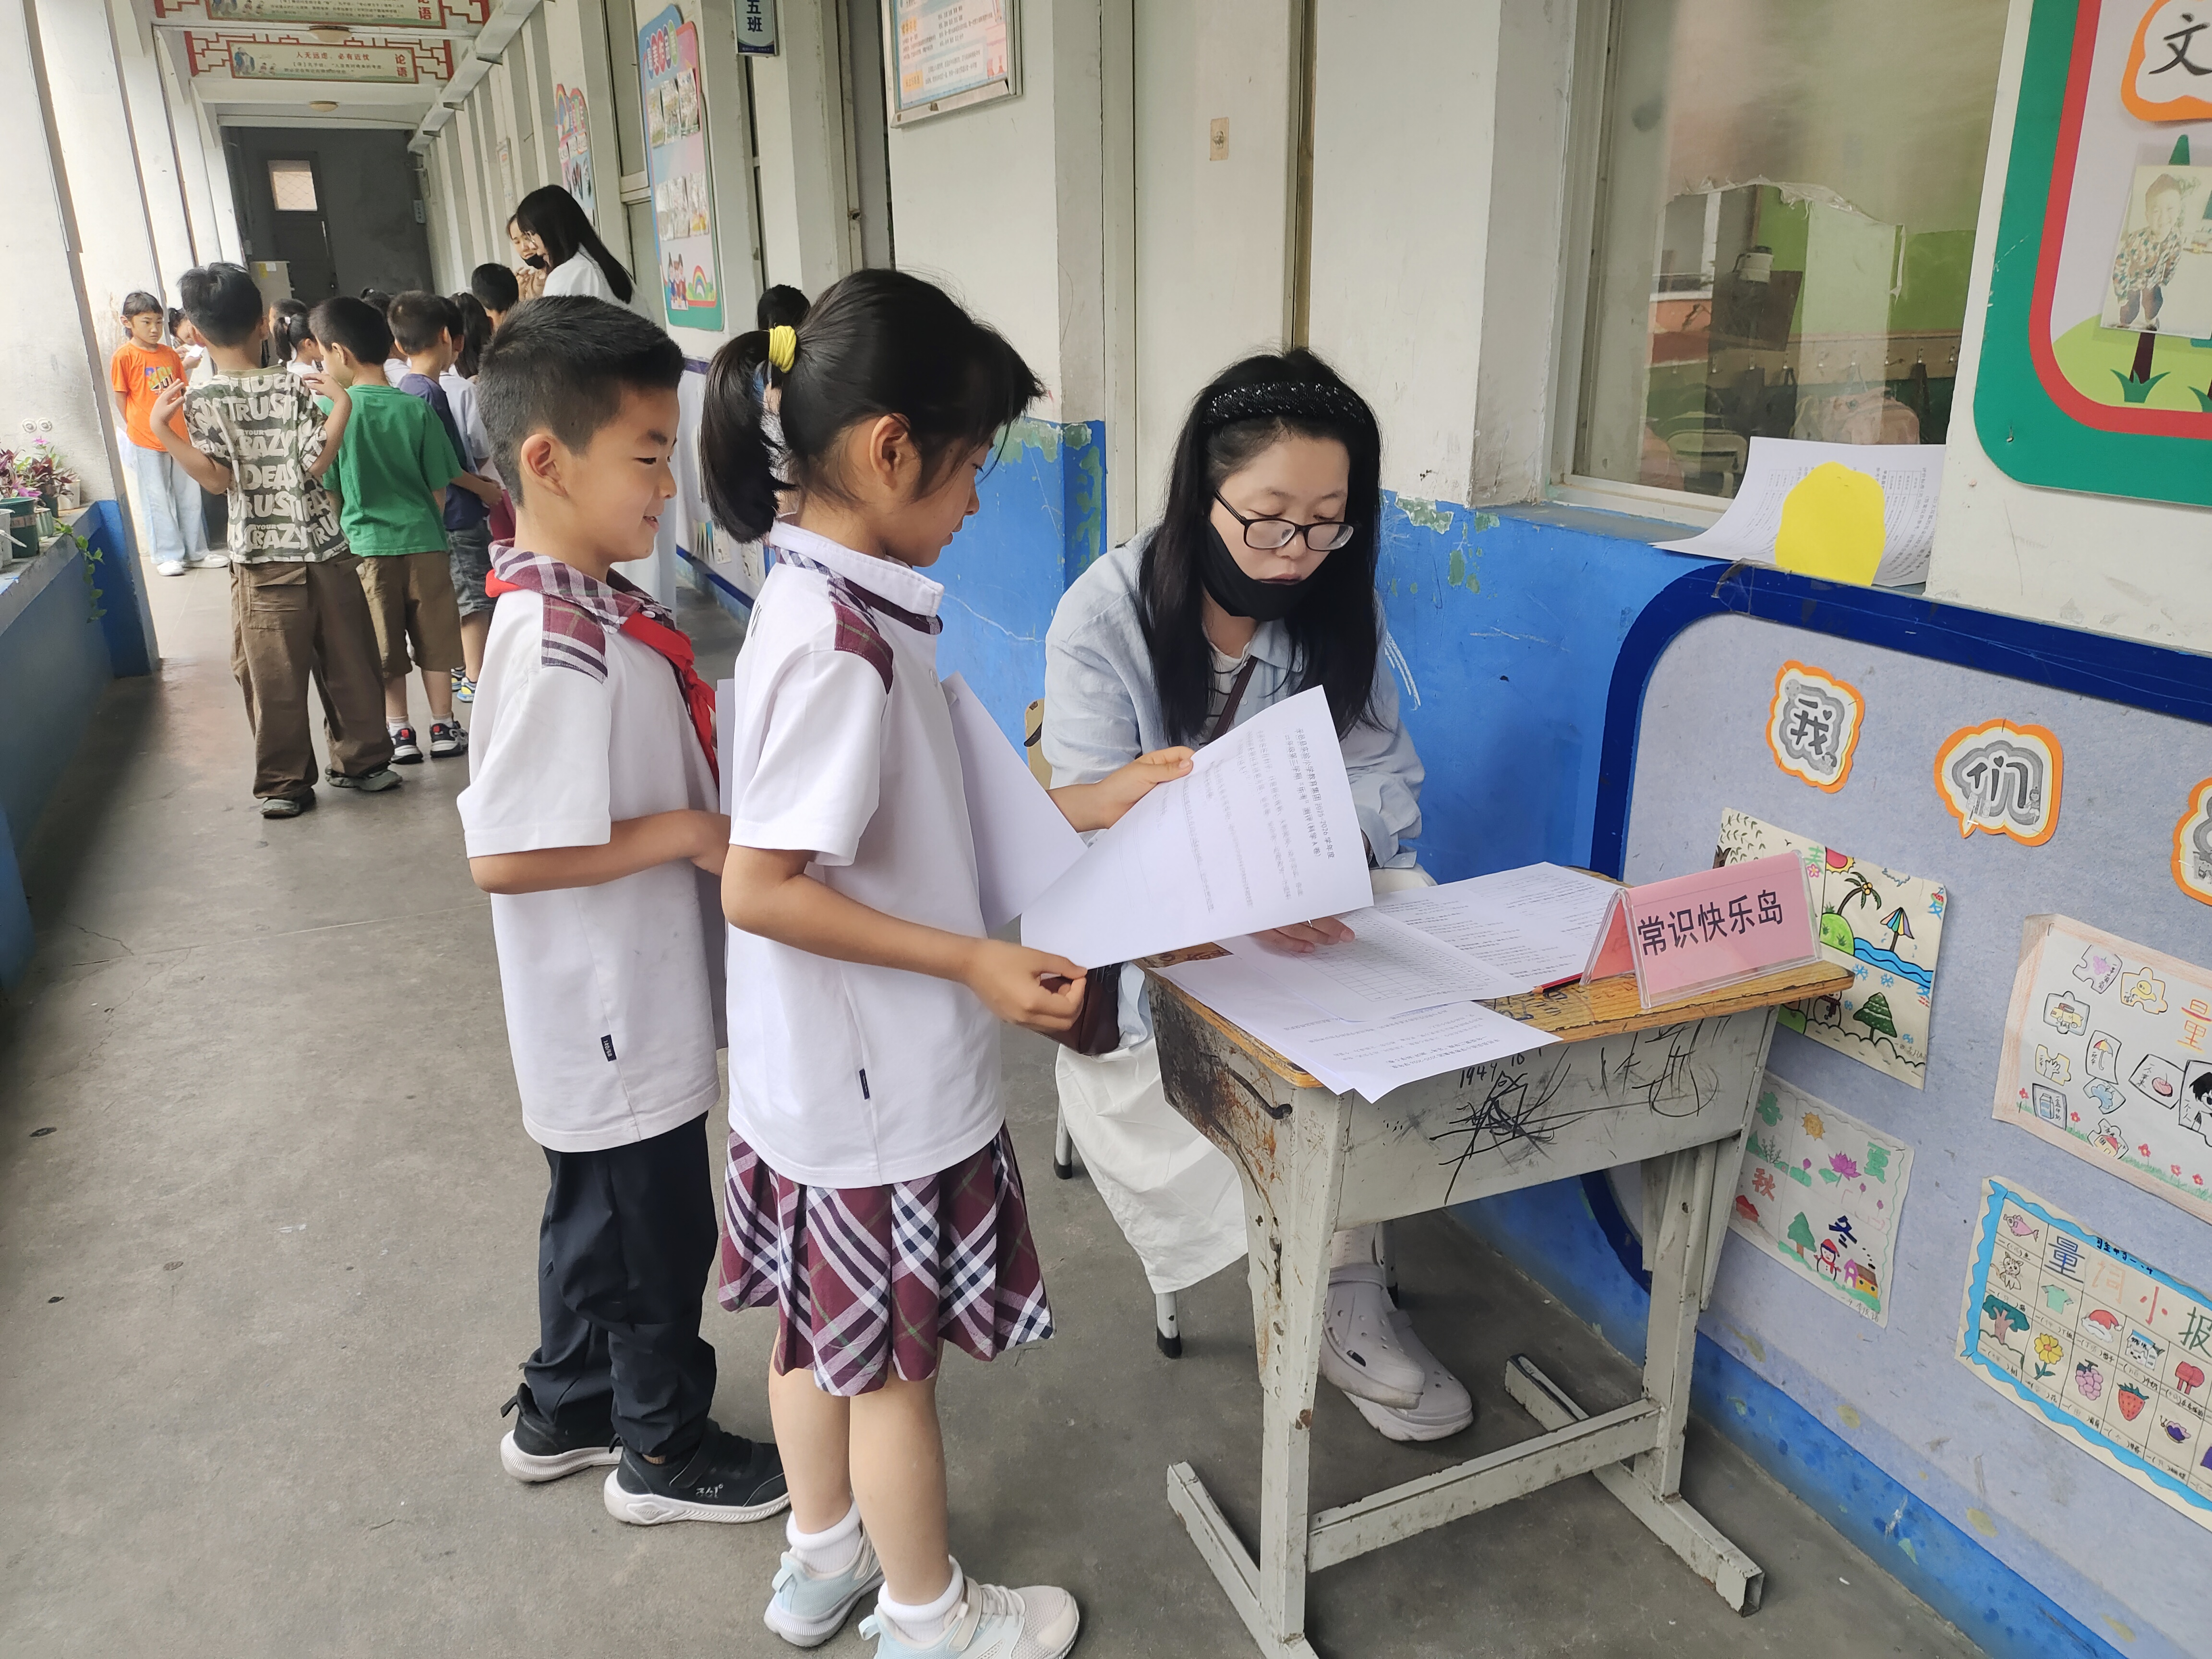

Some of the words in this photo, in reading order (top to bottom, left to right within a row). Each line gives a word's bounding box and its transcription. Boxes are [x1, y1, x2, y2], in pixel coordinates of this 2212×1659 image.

[746, 0, 763, 32] 五班
[2148, 12, 2212, 76] 文
[395, 53, 408, 77] 论语
[1791, 698, 1832, 756] 我
[1967, 756, 2027, 809] 们
[1638, 889, 1783, 956] 常识快乐岛
[1752, 1167, 1776, 1201] 秋
[1828, 1215, 1858, 1248] 冬
